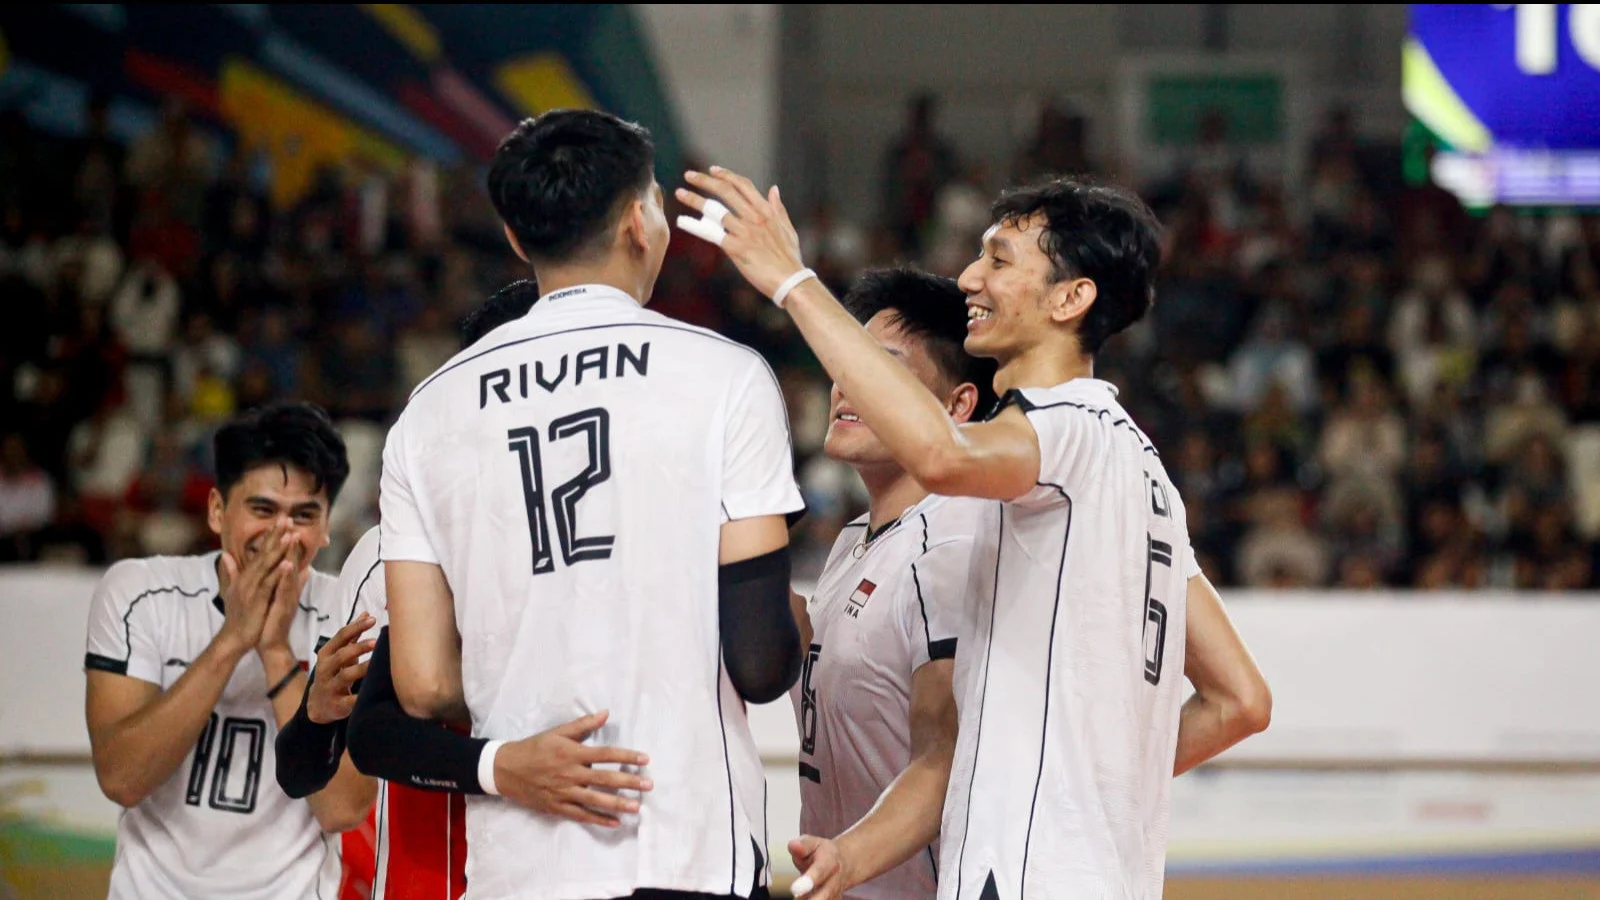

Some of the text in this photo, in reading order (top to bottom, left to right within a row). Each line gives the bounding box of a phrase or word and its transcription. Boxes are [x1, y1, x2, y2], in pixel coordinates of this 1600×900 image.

[479, 342, 651, 410] RIVAN
[507, 406, 616, 576] 12
[843, 603, 860, 619] INA
[185, 711, 267, 814] 10
